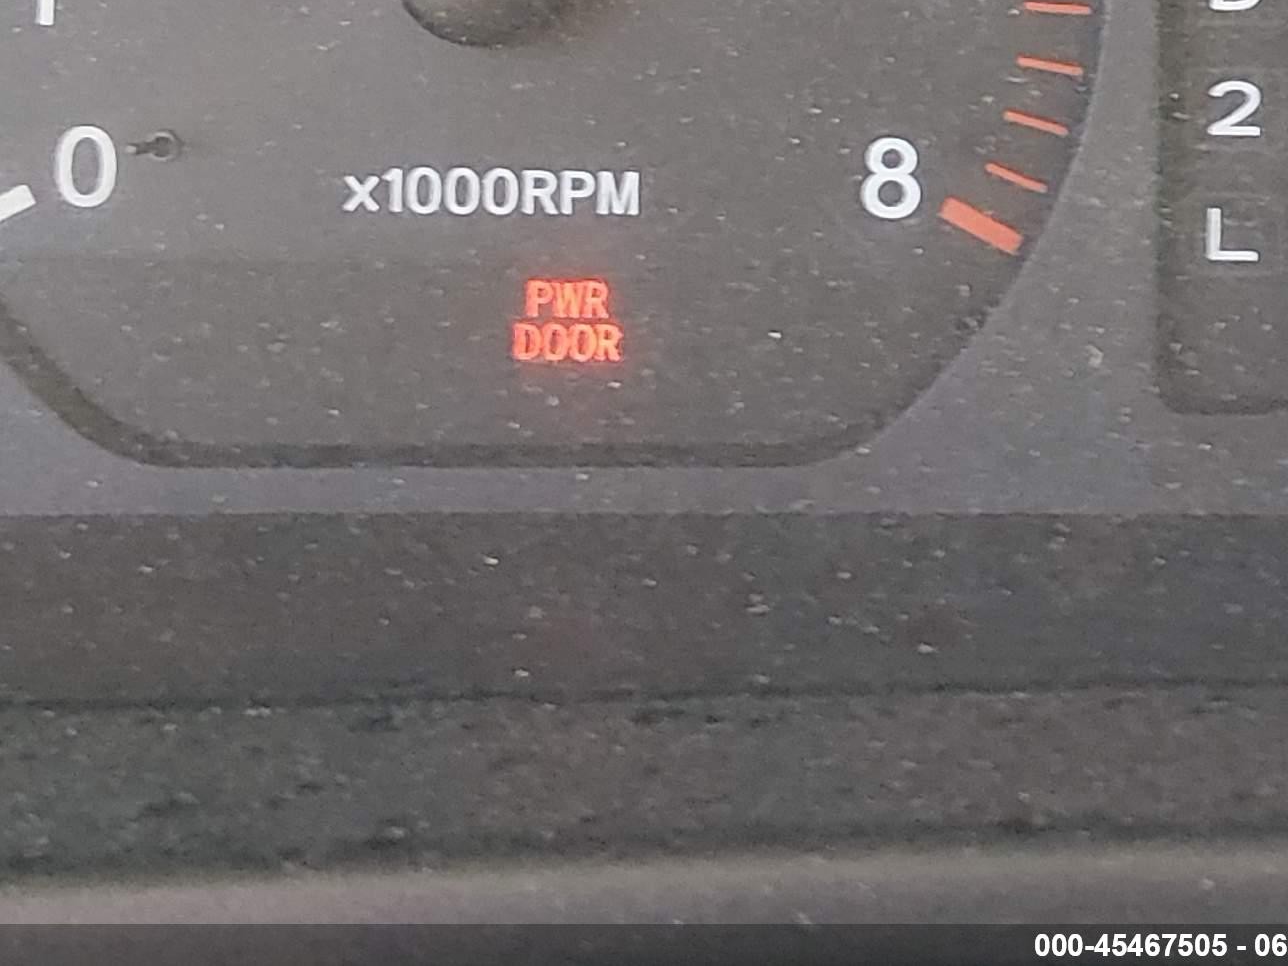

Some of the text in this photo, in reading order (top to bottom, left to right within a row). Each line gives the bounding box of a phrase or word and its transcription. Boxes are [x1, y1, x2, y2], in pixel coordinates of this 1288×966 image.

[1208, 81, 1260, 136] 2
[56, 126, 116, 207] 0
[344, 167, 639, 215] x1000RPM
[862, 138, 920, 218] 8
[1207, 208, 1258, 261] L
[524, 279, 609, 318] PWR
[513, 324, 623, 362] DOOR
